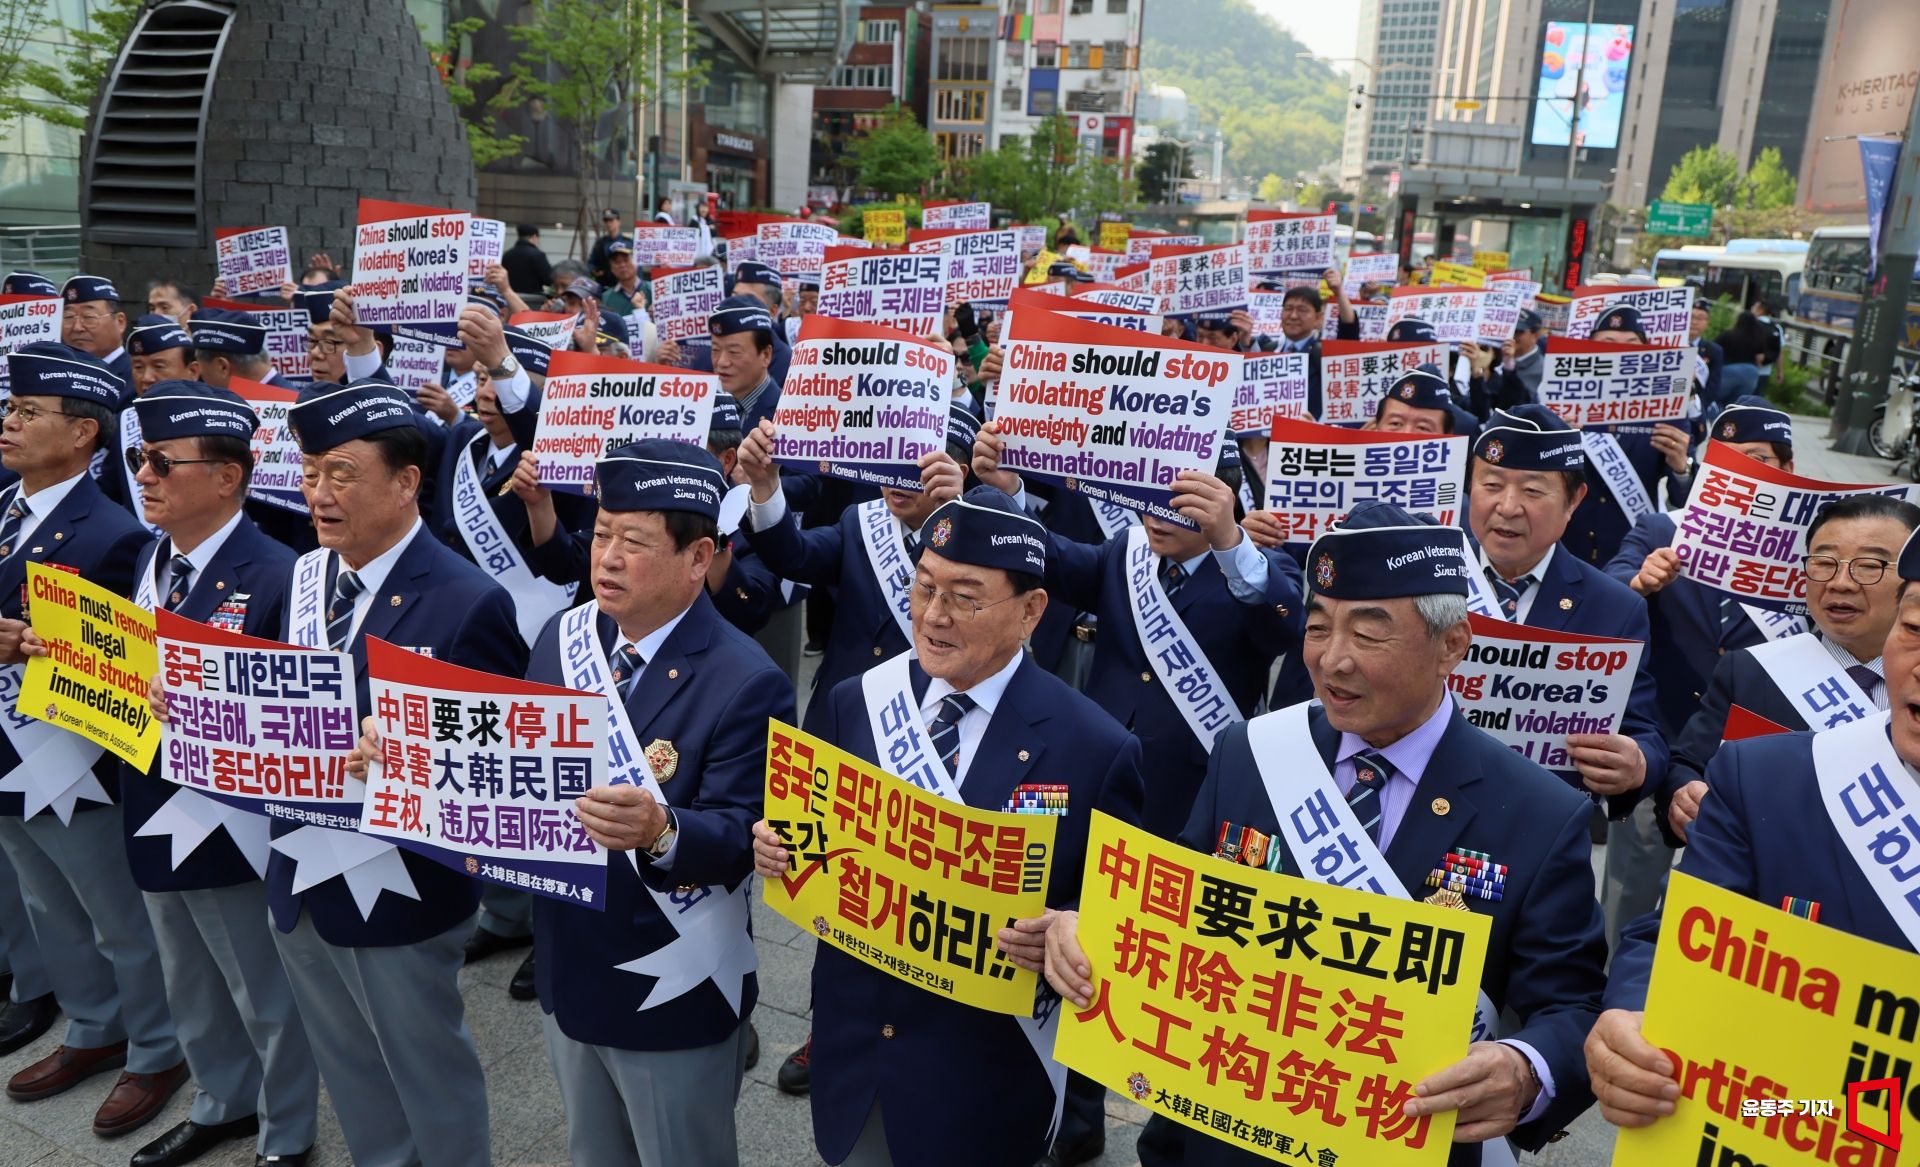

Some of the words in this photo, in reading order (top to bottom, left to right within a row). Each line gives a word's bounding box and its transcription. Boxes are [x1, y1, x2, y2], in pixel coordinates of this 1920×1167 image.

[1838, 71, 1919, 99] K-HERITAG
[949, 204, 986, 219] 대한민국
[239, 229, 282, 251] 대한민국
[359, 224, 385, 246] China
[388, 219, 428, 242] should
[432, 218, 464, 239] stop
[791, 225, 834, 242] 대한민국
[1248, 219, 1330, 237] 中国要求停止
[254, 248, 287, 267] 국제법
[759, 241, 799, 257] 주권침해,
[955, 233, 1015, 256] 대한민국
[359, 249, 405, 271] violating
[408, 247, 458, 266] Korea's
[972, 255, 1018, 275] 국제법
[1153, 249, 1243, 278] 中国要求停止
[239, 268, 286, 291] 중단하라!!
[352, 279, 399, 300] sovereignty
[401, 275, 418, 293] and
[420, 272, 463, 294] violating
[673, 270, 718, 294] 대한민국
[824, 263, 858, 291] 중국은
[861, 257, 941, 286] 대한민국
[1151, 267, 1243, 295] 侵害大韩民国
[357, 301, 431, 321] international
[434, 302, 456, 318] law
[818, 289, 877, 317] 주권침해,
[881, 286, 943, 314] 국제법
[1392, 296, 1477, 312] 中国要求停止
[1620, 289, 1687, 312] 대한민국
[399, 325, 414, 337] Korean
[414, 329, 431, 341] Veterans
[432, 335, 463, 347] Association
[395, 353, 438, 372] violating
[822, 342, 900, 365] should
[904, 348, 947, 378] stop
[1010, 344, 1067, 372] China
[1071, 347, 1160, 377] should
[1163, 353, 1229, 387] stop
[1244, 356, 1303, 380] 대한민국
[1327, 349, 1441, 377] 中国要求停止
[1554, 357, 1613, 377] 정부는
[1619, 351, 1684, 375] 동일한
[40, 371, 67, 381] Korean
[67, 371, 98, 383] Veterans
[72, 382, 91, 390] Since
[92, 386, 108, 397] 1952
[547, 381, 586, 399] China
[590, 377, 656, 397] should
[659, 377, 708, 402] stop
[857, 373, 940, 402] Korea's
[1263, 379, 1306, 402] 국제법
[1545, 379, 1603, 400] 규모의
[1609, 375, 1687, 399] 구조물을
[328, 405, 355, 425] Korean
[354, 397, 387, 410] Veterans
[1009, 378, 1106, 415] violating
[1109, 384, 1212, 417] Korea's
[1587, 396, 1684, 421] 설치하라!!
[169, 410, 199, 423] Korean
[199, 408, 232, 418] Veterans
[205, 418, 227, 428] Since
[228, 421, 243, 431] 1952
[367, 410, 387, 422] Since
[388, 408, 403, 417] 1952
[545, 405, 616, 430] violating
[619, 405, 696, 425] Korea's
[843, 405, 873, 428] and
[876, 404, 944, 438] violating
[535, 434, 603, 457] sovereignty
[606, 432, 633, 451] and
[770, 434, 894, 460] nternational
[996, 413, 1090, 448] sovereignty
[1091, 421, 1127, 446] and
[1129, 421, 1217, 460] violating
[1001, 442, 1146, 483] international
[1280, 447, 1356, 477] 정부는
[1364, 442, 1450, 477] 동일한
[1540, 446, 1562, 460] Korean
[1565, 457, 1577, 466] Since
[535, 460, 594, 480] interna
[635, 478, 667, 492] Korean
[666, 475, 702, 487] Veterans
[832, 463, 858, 478] Korean
[859, 469, 895, 485] Veterans
[674, 488, 696, 500] Since
[697, 491, 712, 504] 1952
[1078, 481, 1108, 499] Korean
[1109, 490, 1145, 511] Veterans
[1147, 503, 1195, 528] Association
[1269, 479, 1343, 509] 규모의
[1698, 470, 1776, 520] 중국은
[991, 534, 1021, 547] Korean
[1680, 505, 1800, 563] 주권침해,
[1026, 551, 1042, 563] Since
[1387, 549, 1425, 571] Korean
[1424, 545, 1460, 559] Veterans
[1434, 564, 1456, 577] Since
[1675, 543, 1730, 586] 위반
[33, 575, 77, 609] China
[80, 594, 112, 622] must
[81, 619, 126, 660] illegal
[567, 603, 606, 695] 대한민
[164, 644, 219, 691] 중국은
[224, 652, 342, 700] 대한민국
[1464, 643, 1550, 672] hould
[1555, 647, 1627, 676] stop
[99, 659, 151, 700] structu
[1490, 673, 1608, 704] Korea's
[50, 669, 151, 738] immediately
[164, 691, 255, 747] 주권침해,
[261, 704, 354, 750] 국제법
[377, 688, 594, 749] 中国要求停止
[1468, 708, 1512, 731] and
[1514, 711, 1615, 734] violating
[59, 710, 84, 731] Korean
[85, 721, 109, 743] Veterans
[109, 734, 138, 758] Association
[170, 739, 209, 786] 위반
[213, 748, 346, 798] 중단하라!!
[381, 737, 591, 801] 侵害大韩民国
[769, 731, 829, 818] 중국은
[833, 762, 883, 846] 무단
[884, 788, 1046, 895] 인공구조물을
[1099, 838, 1465, 995] 中国要求立即
[833, 929, 954, 993] 대한민국재향군인회
[1678, 906, 1840, 1017] China
[1113, 917, 1404, 1064] 拆除非法
[1074, 979, 1434, 1150] 人工构筑物
